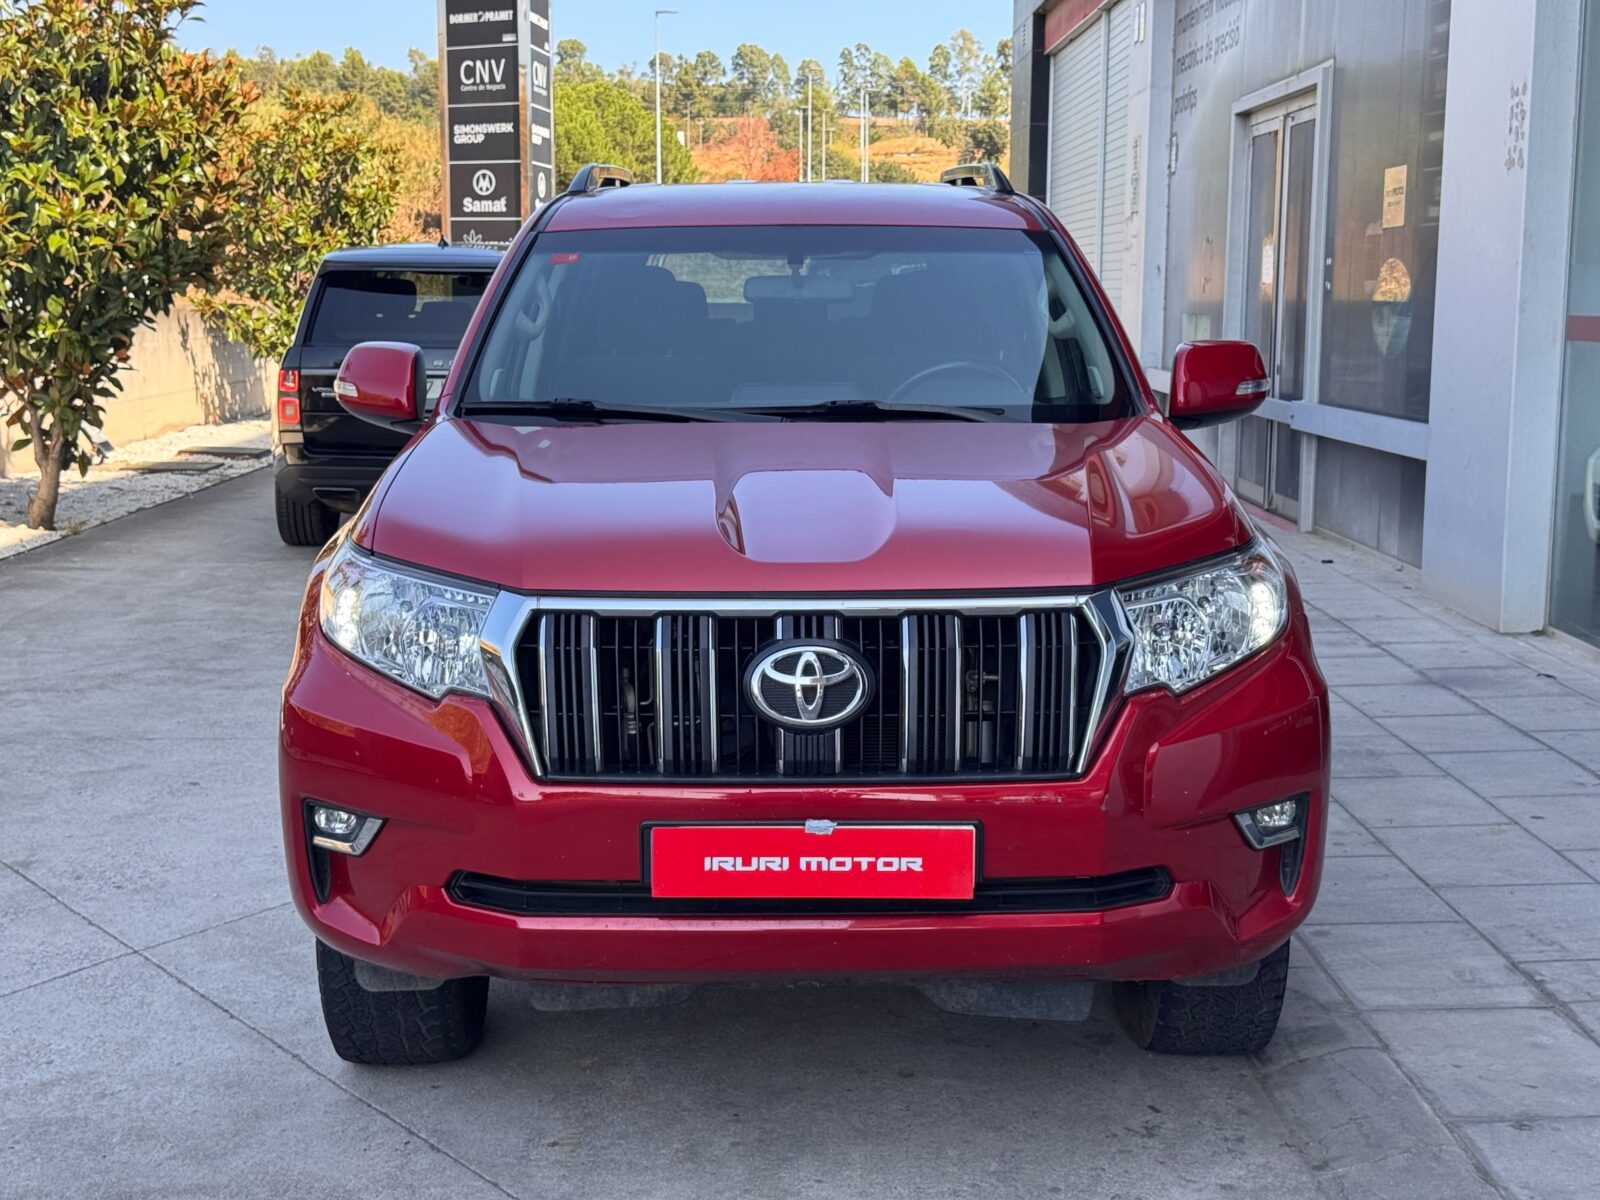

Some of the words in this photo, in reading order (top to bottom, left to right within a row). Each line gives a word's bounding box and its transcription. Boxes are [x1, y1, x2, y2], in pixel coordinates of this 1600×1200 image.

[1205, 34, 1213, 61] de
[459, 57, 506, 85] CNV
[532, 60, 548, 89] CNV
[453, 122, 514, 135] SIMONSWERK
[453, 134, 485, 144] GROUP
[463, 196, 507, 213] Samat
[704, 856, 789, 872] IRURI
[800, 856, 923, 872] MOTOR
